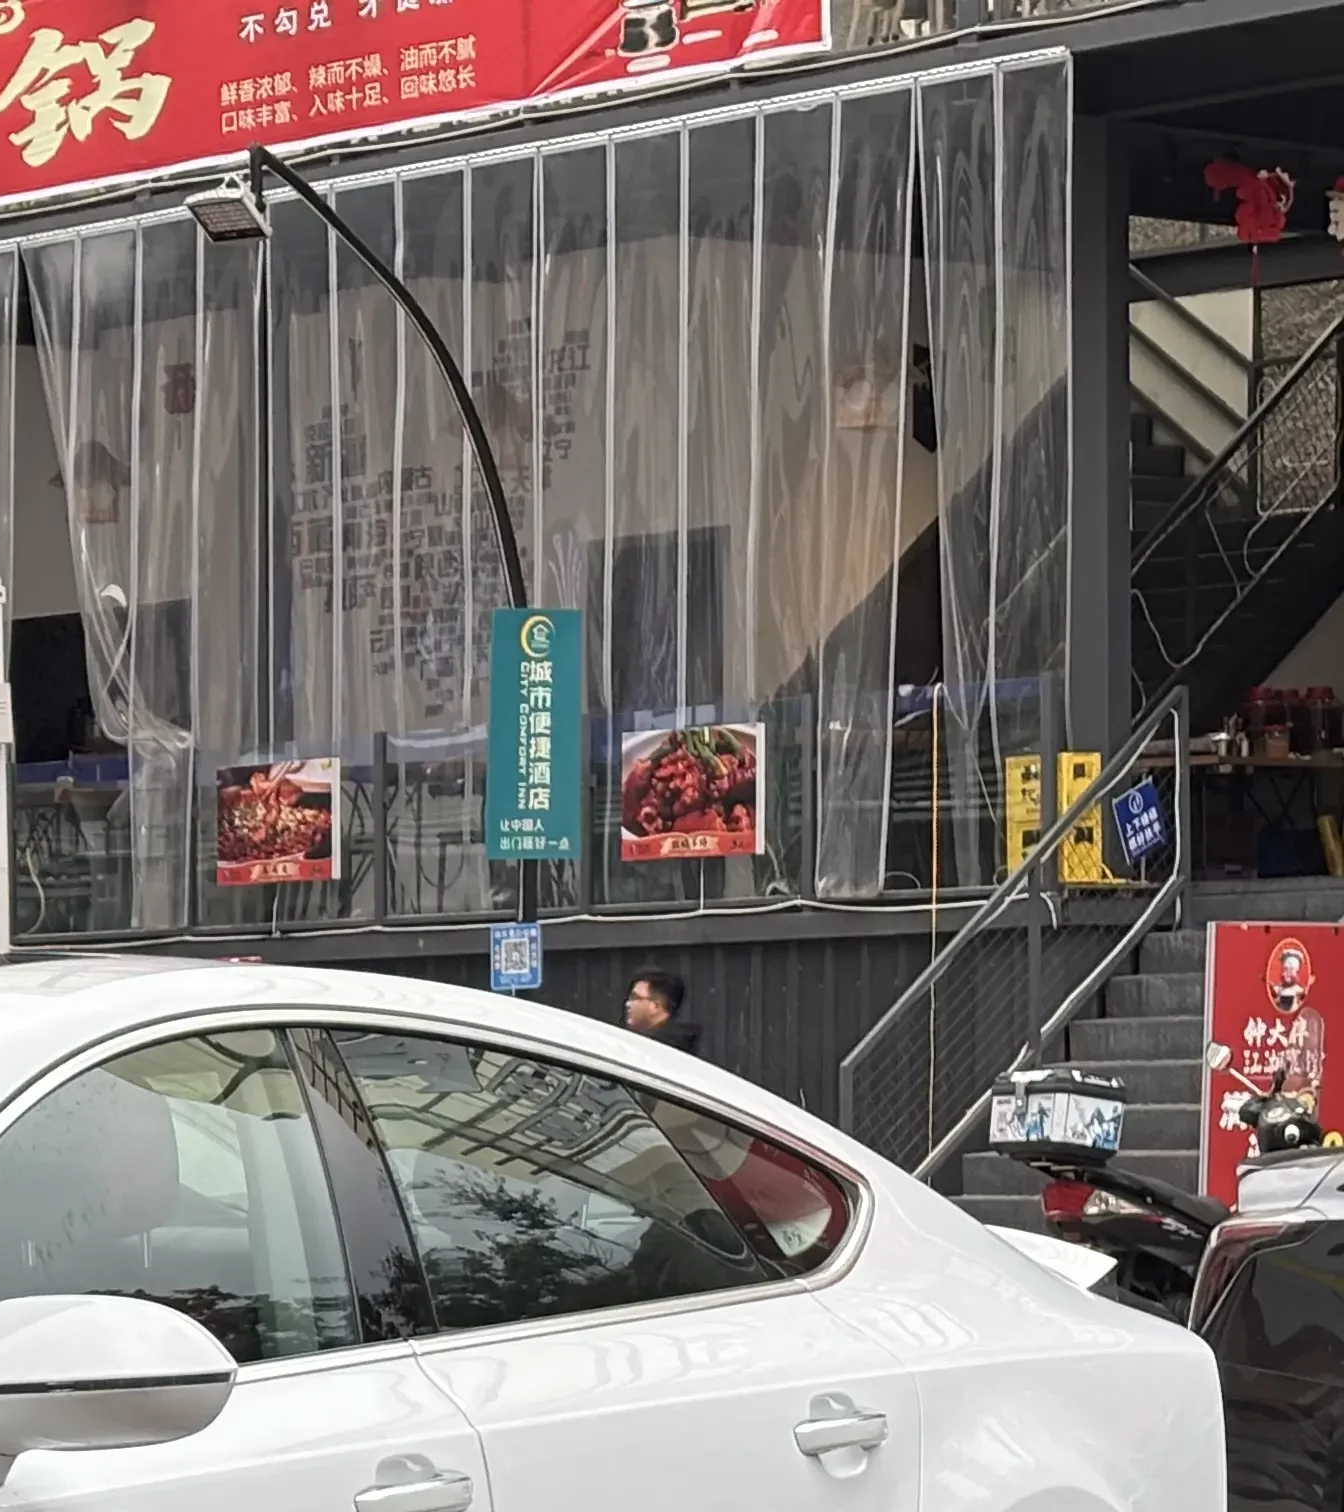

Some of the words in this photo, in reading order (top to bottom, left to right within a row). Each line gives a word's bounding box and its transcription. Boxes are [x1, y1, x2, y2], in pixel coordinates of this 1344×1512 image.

[519, 661, 529, 697] CITY
[518, 703, 529, 777] COMFORT
[527, 660, 553, 811] 城市便捷酒店
[517, 781, 528, 810] INN
